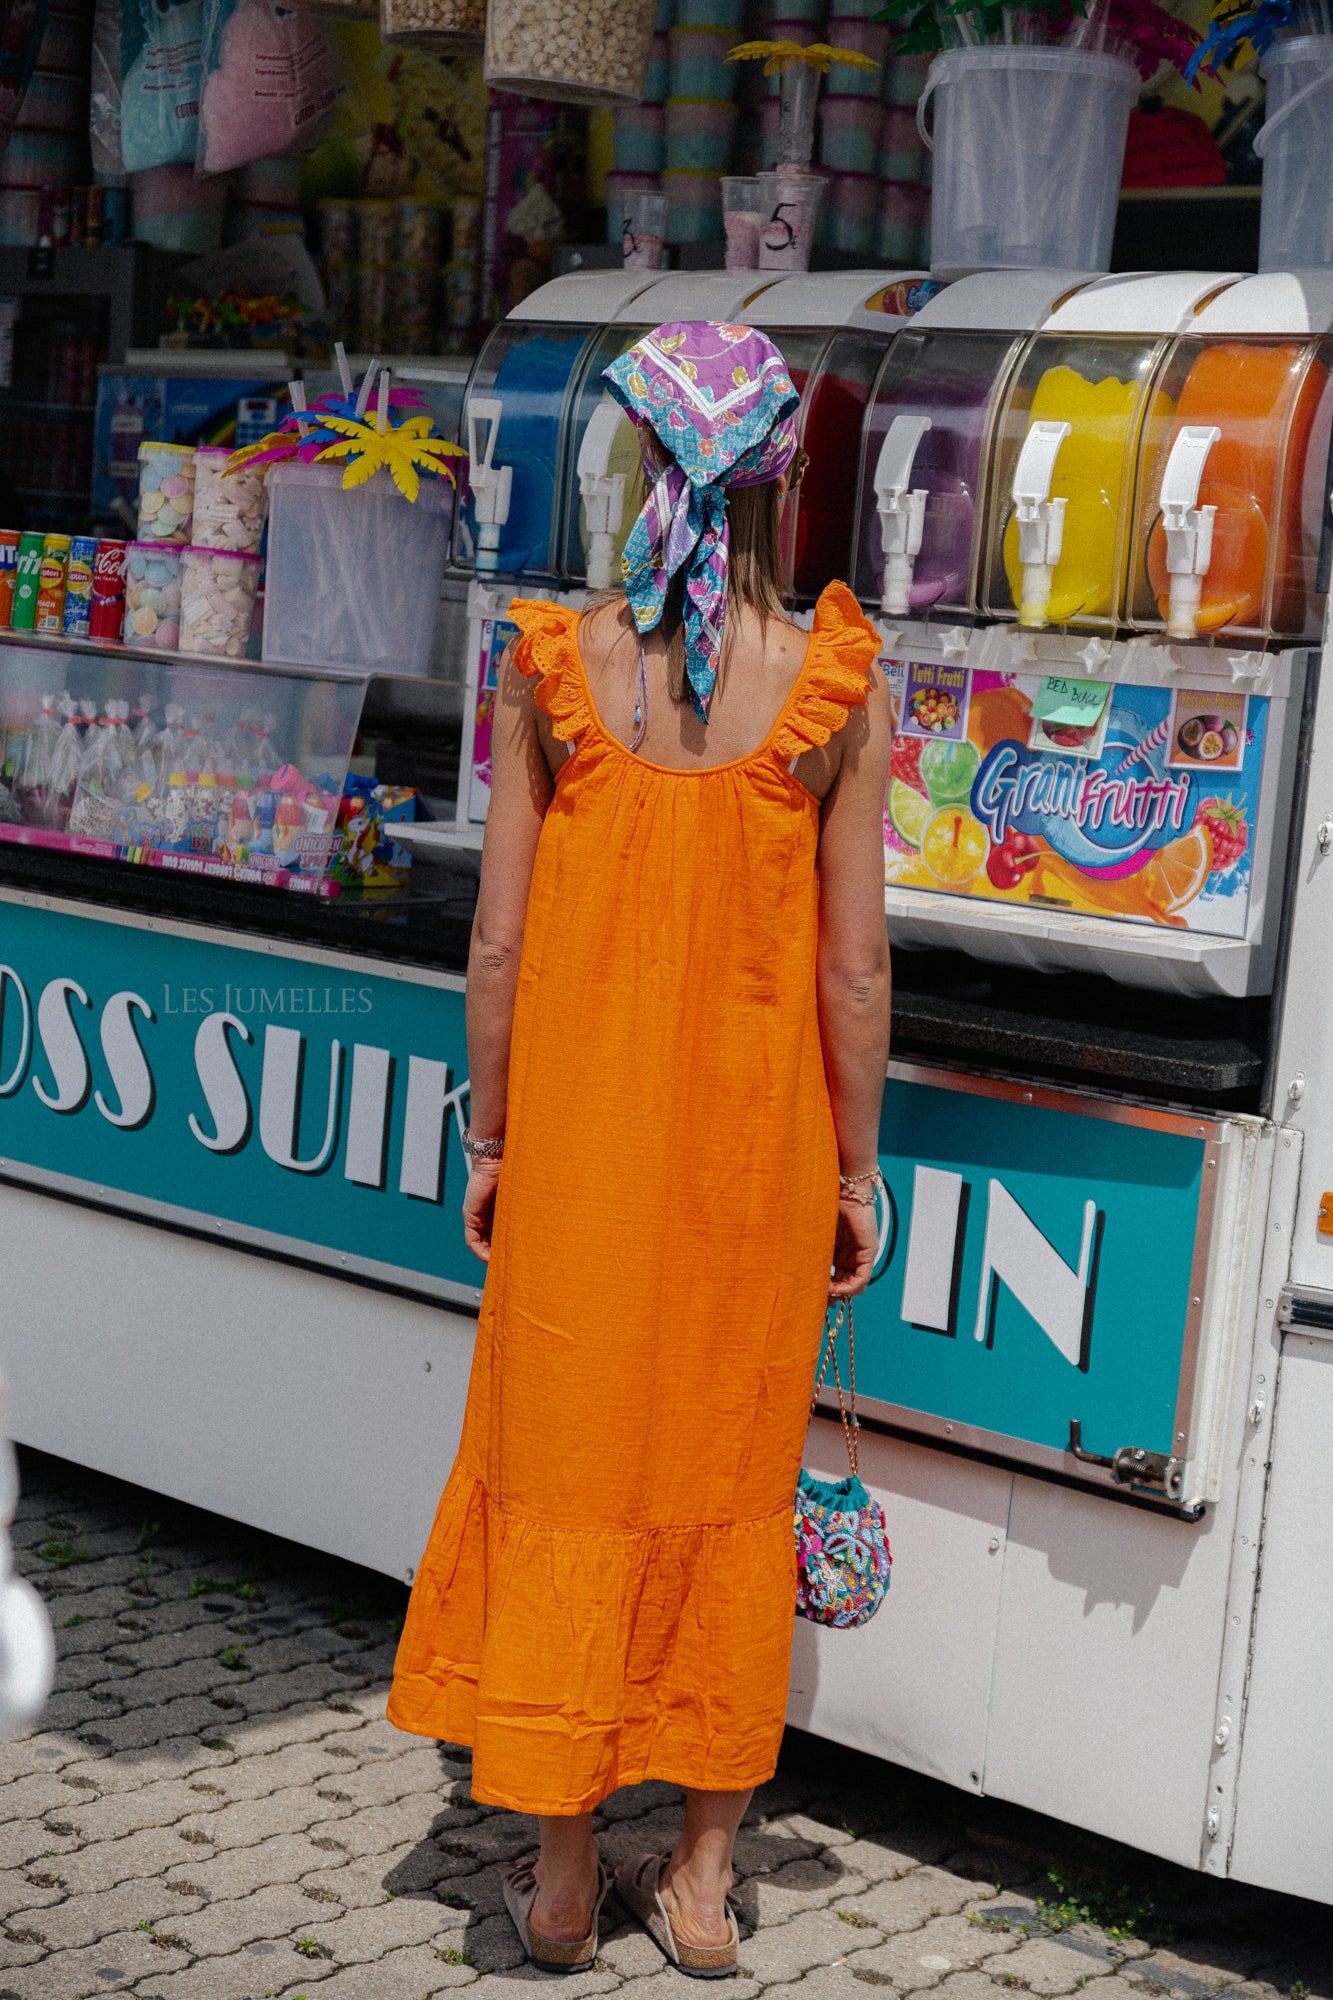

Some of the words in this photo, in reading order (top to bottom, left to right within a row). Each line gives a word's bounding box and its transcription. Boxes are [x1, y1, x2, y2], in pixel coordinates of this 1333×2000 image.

[912, 663, 935, 684] Tutti
[937, 667, 965, 688] Frutti
[1047, 676, 1068, 694] RED
[294, 835, 343, 853] UNICON
[874, 1165, 1097, 1367] IN
